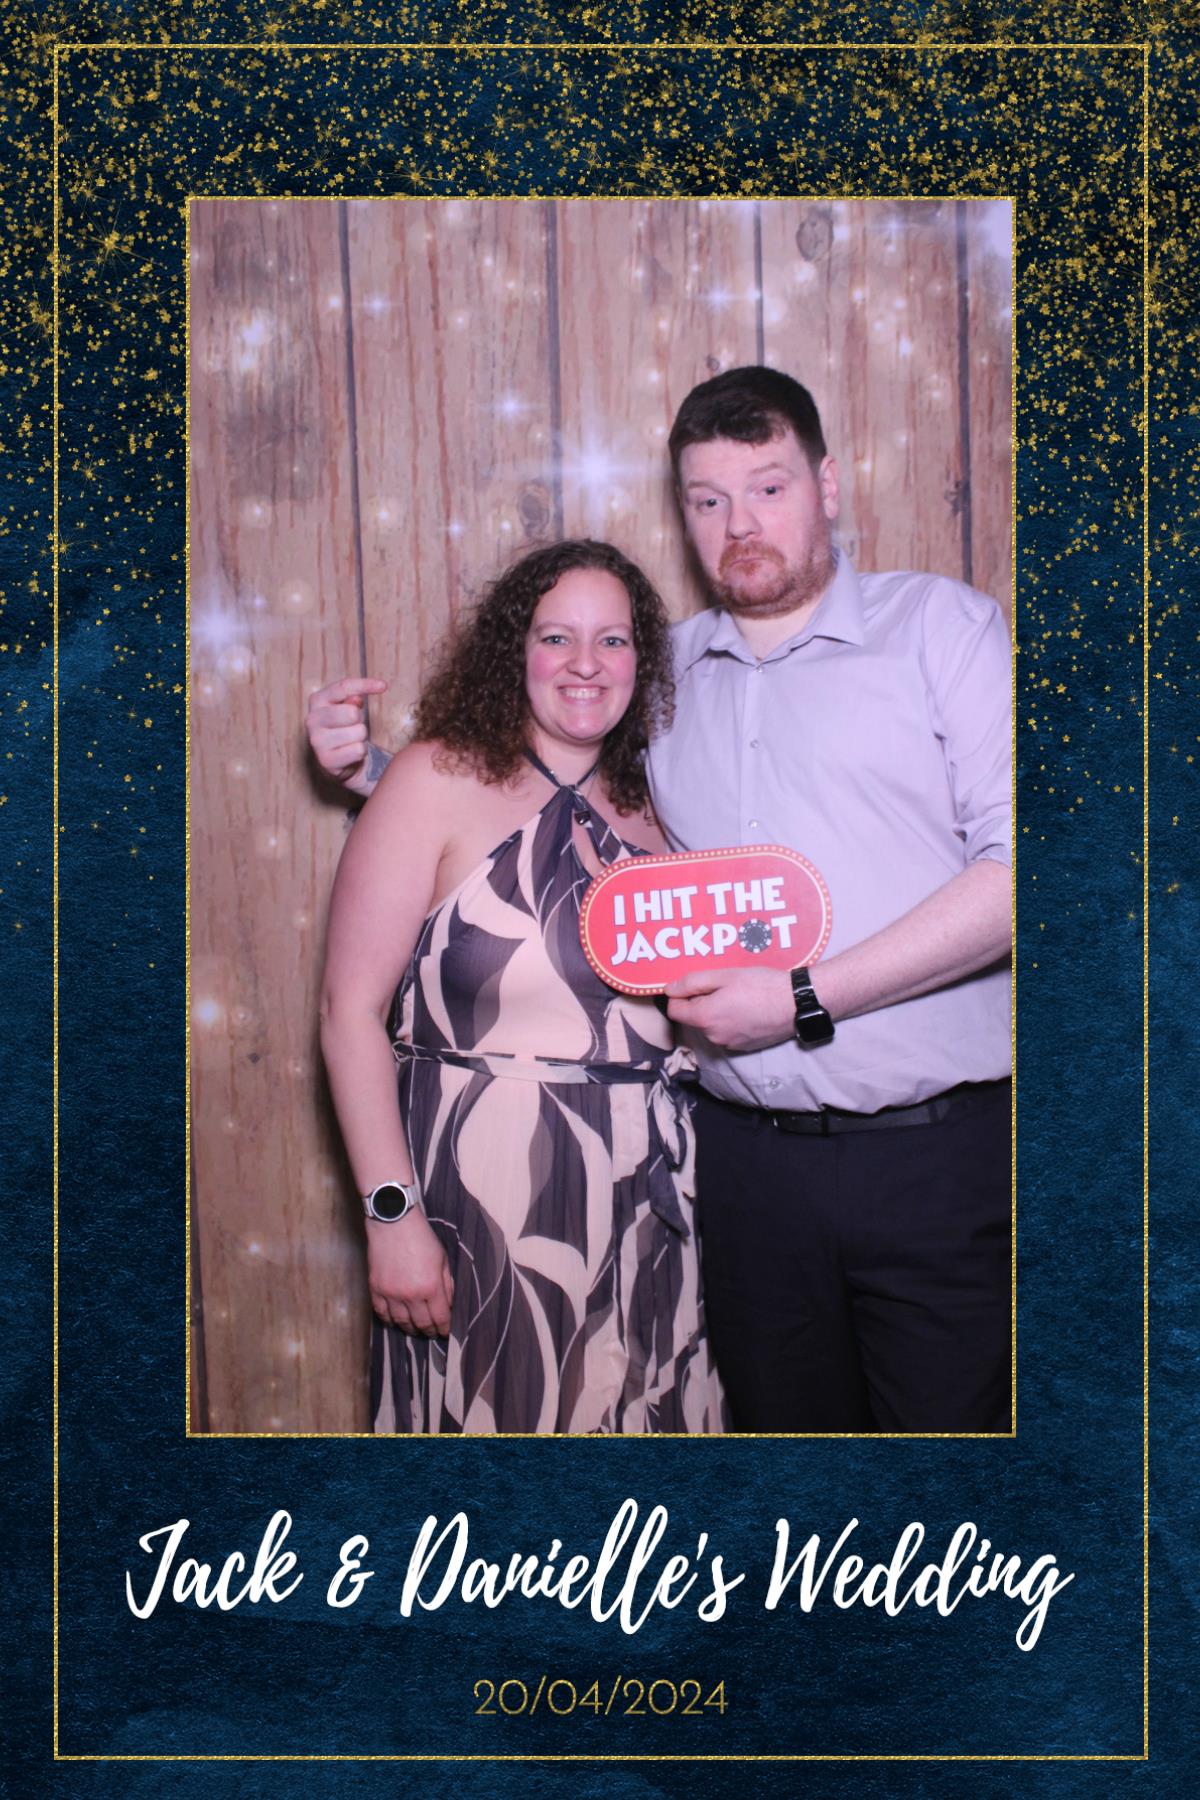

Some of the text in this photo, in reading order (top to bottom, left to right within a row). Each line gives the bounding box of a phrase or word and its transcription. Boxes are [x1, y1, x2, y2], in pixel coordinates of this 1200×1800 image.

[613, 876, 786, 926] I HIT THE
[611, 914, 798, 966] JACKPOT
